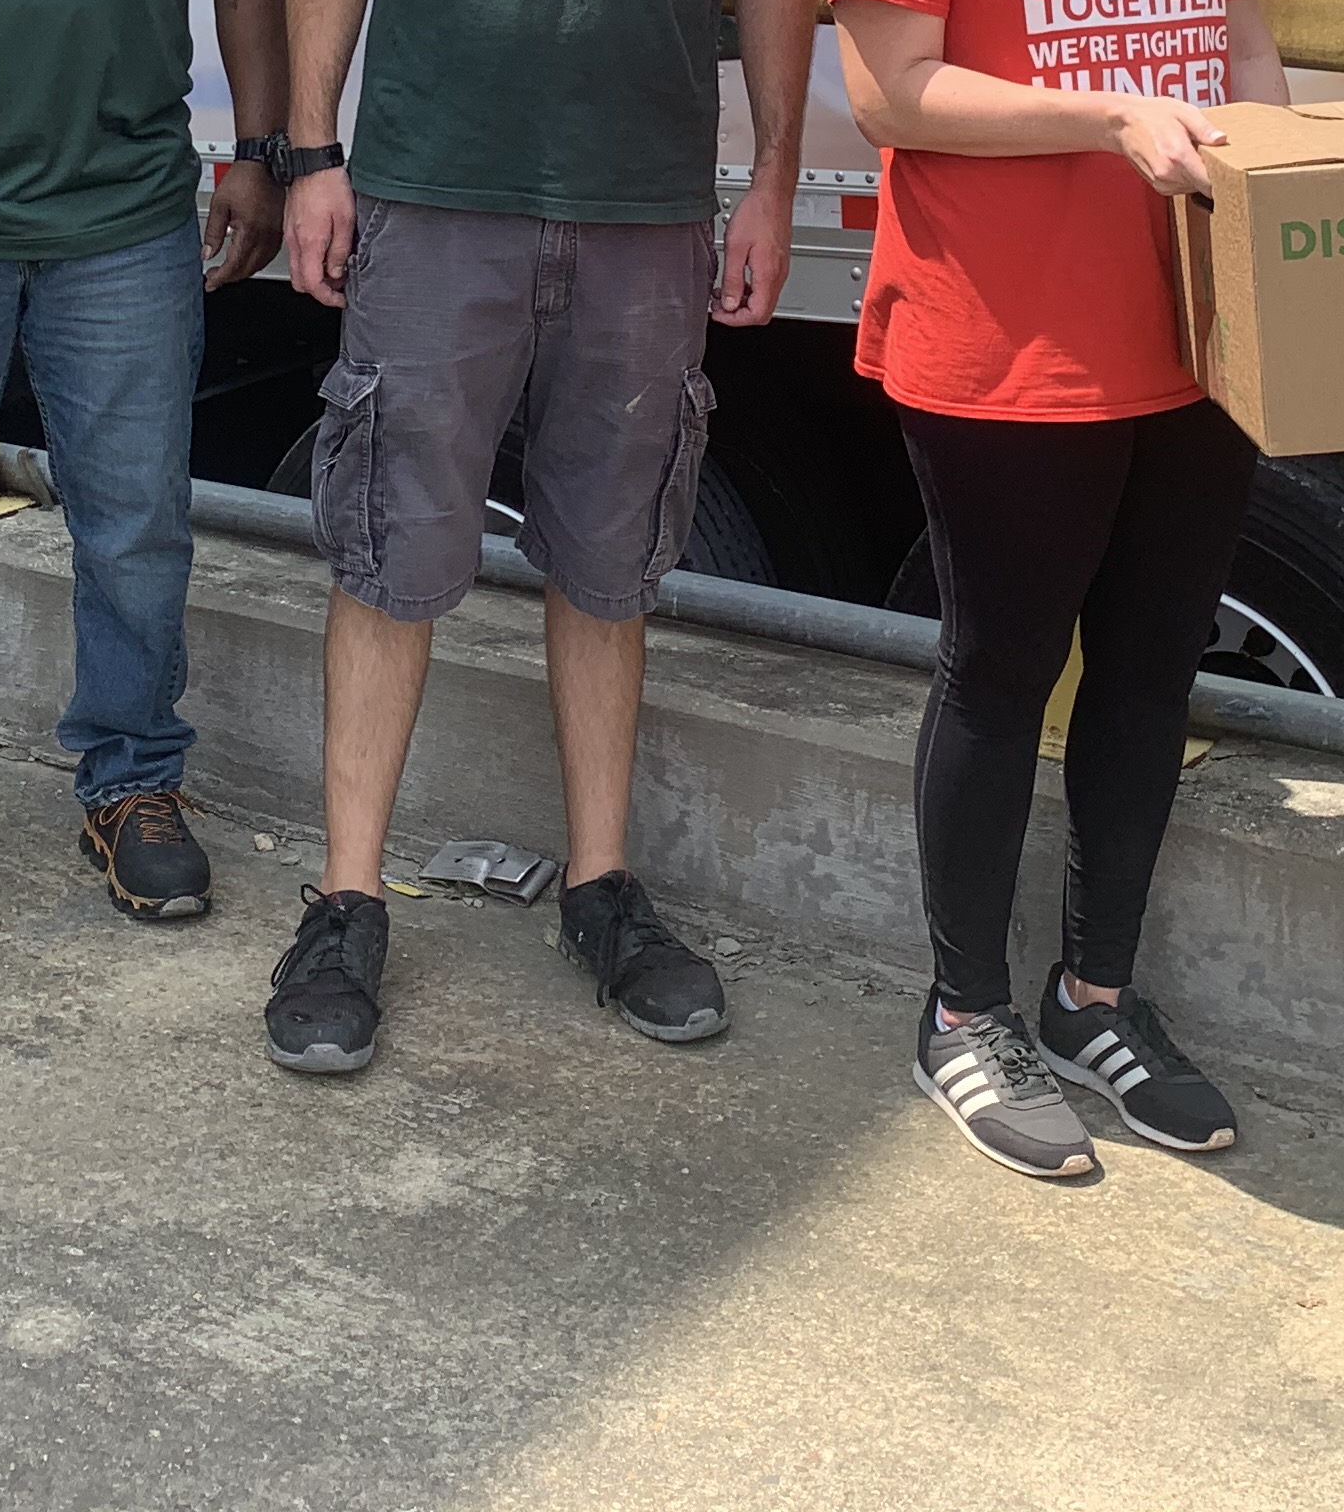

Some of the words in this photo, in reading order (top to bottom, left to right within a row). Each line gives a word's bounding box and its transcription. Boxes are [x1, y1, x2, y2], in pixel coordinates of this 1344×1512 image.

[1027, 34, 1120, 70] WE'RE
[1124, 24, 1228, 61] FIGHTING
[1031, 57, 1227, 108] NGER
